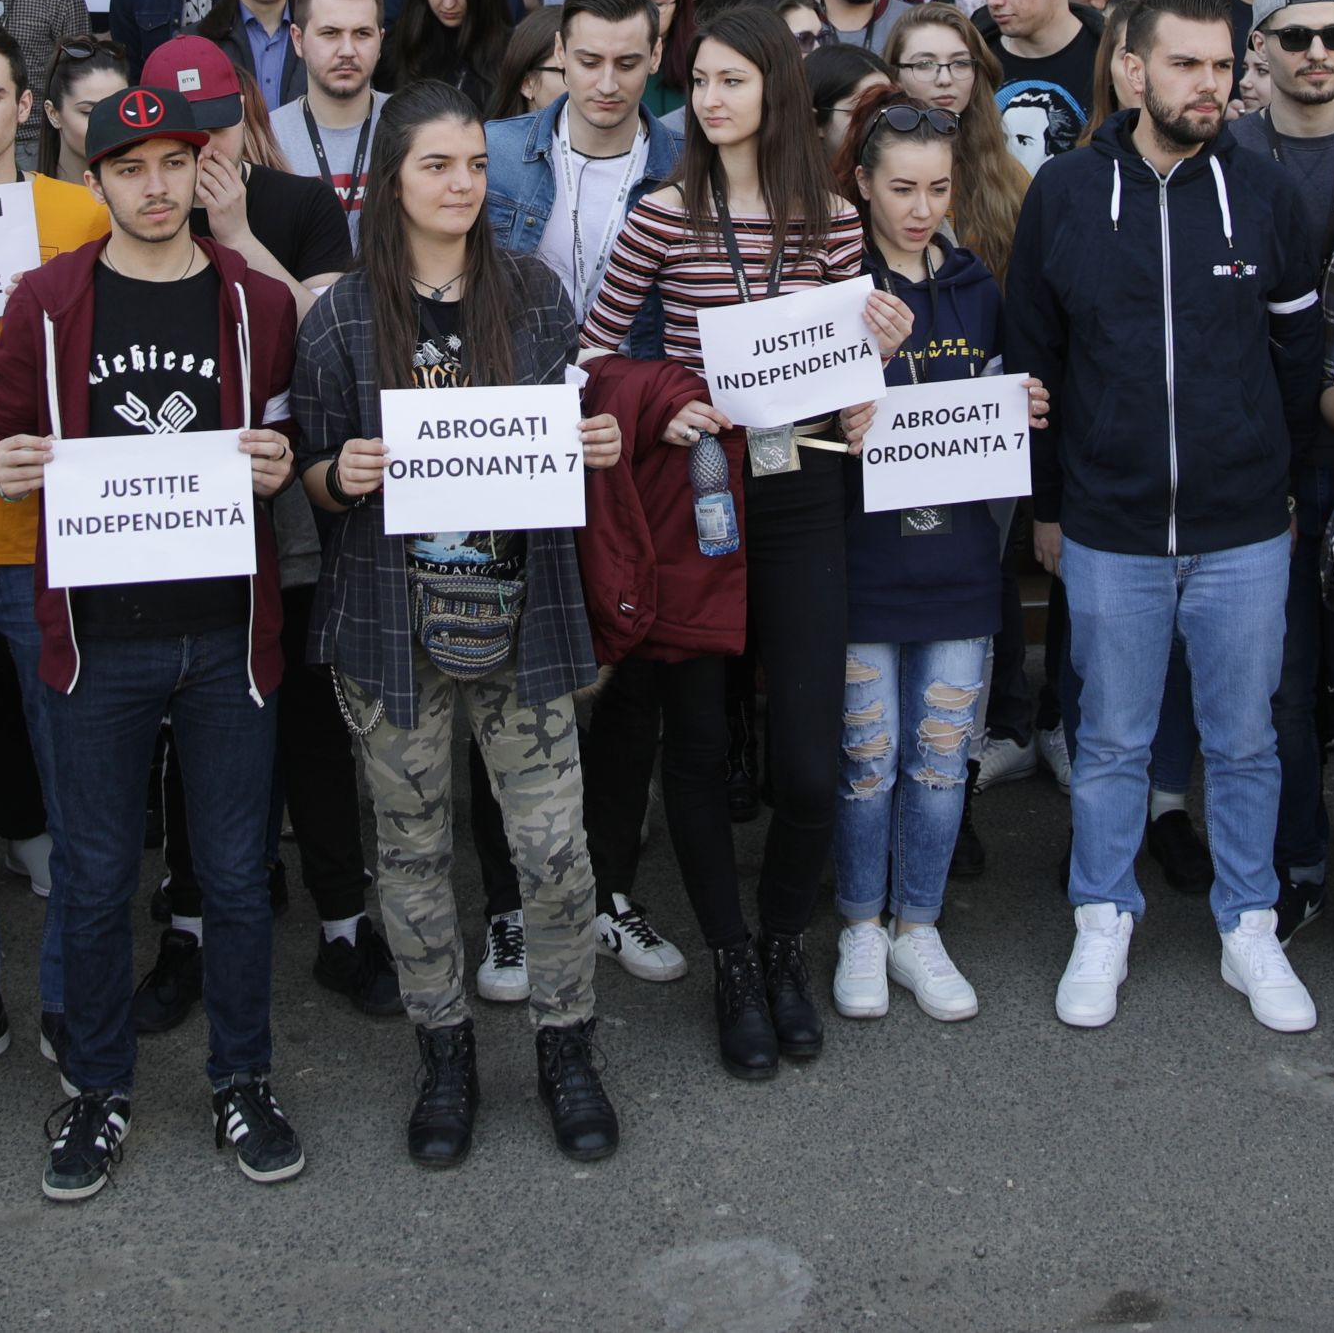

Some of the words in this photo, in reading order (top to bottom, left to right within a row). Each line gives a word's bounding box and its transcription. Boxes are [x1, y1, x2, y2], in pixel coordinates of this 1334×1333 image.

[753, 322, 834, 356] JUSTIȚIE
[717, 338, 872, 389] INDEPENDENTĂ
[418, 417, 546, 441] ABROGAȚI
[892, 403, 999, 430] ABROGAȚI
[867, 435, 1006, 464] ORDONANȚA
[1014, 433, 1024, 449] 7
[388, 454, 556, 479] ORDONANȚA
[566, 454, 577, 472] 7
[101, 475, 199, 499] JUSTIȚIE
[59, 508, 244, 535] INDEPENDENTĂ
